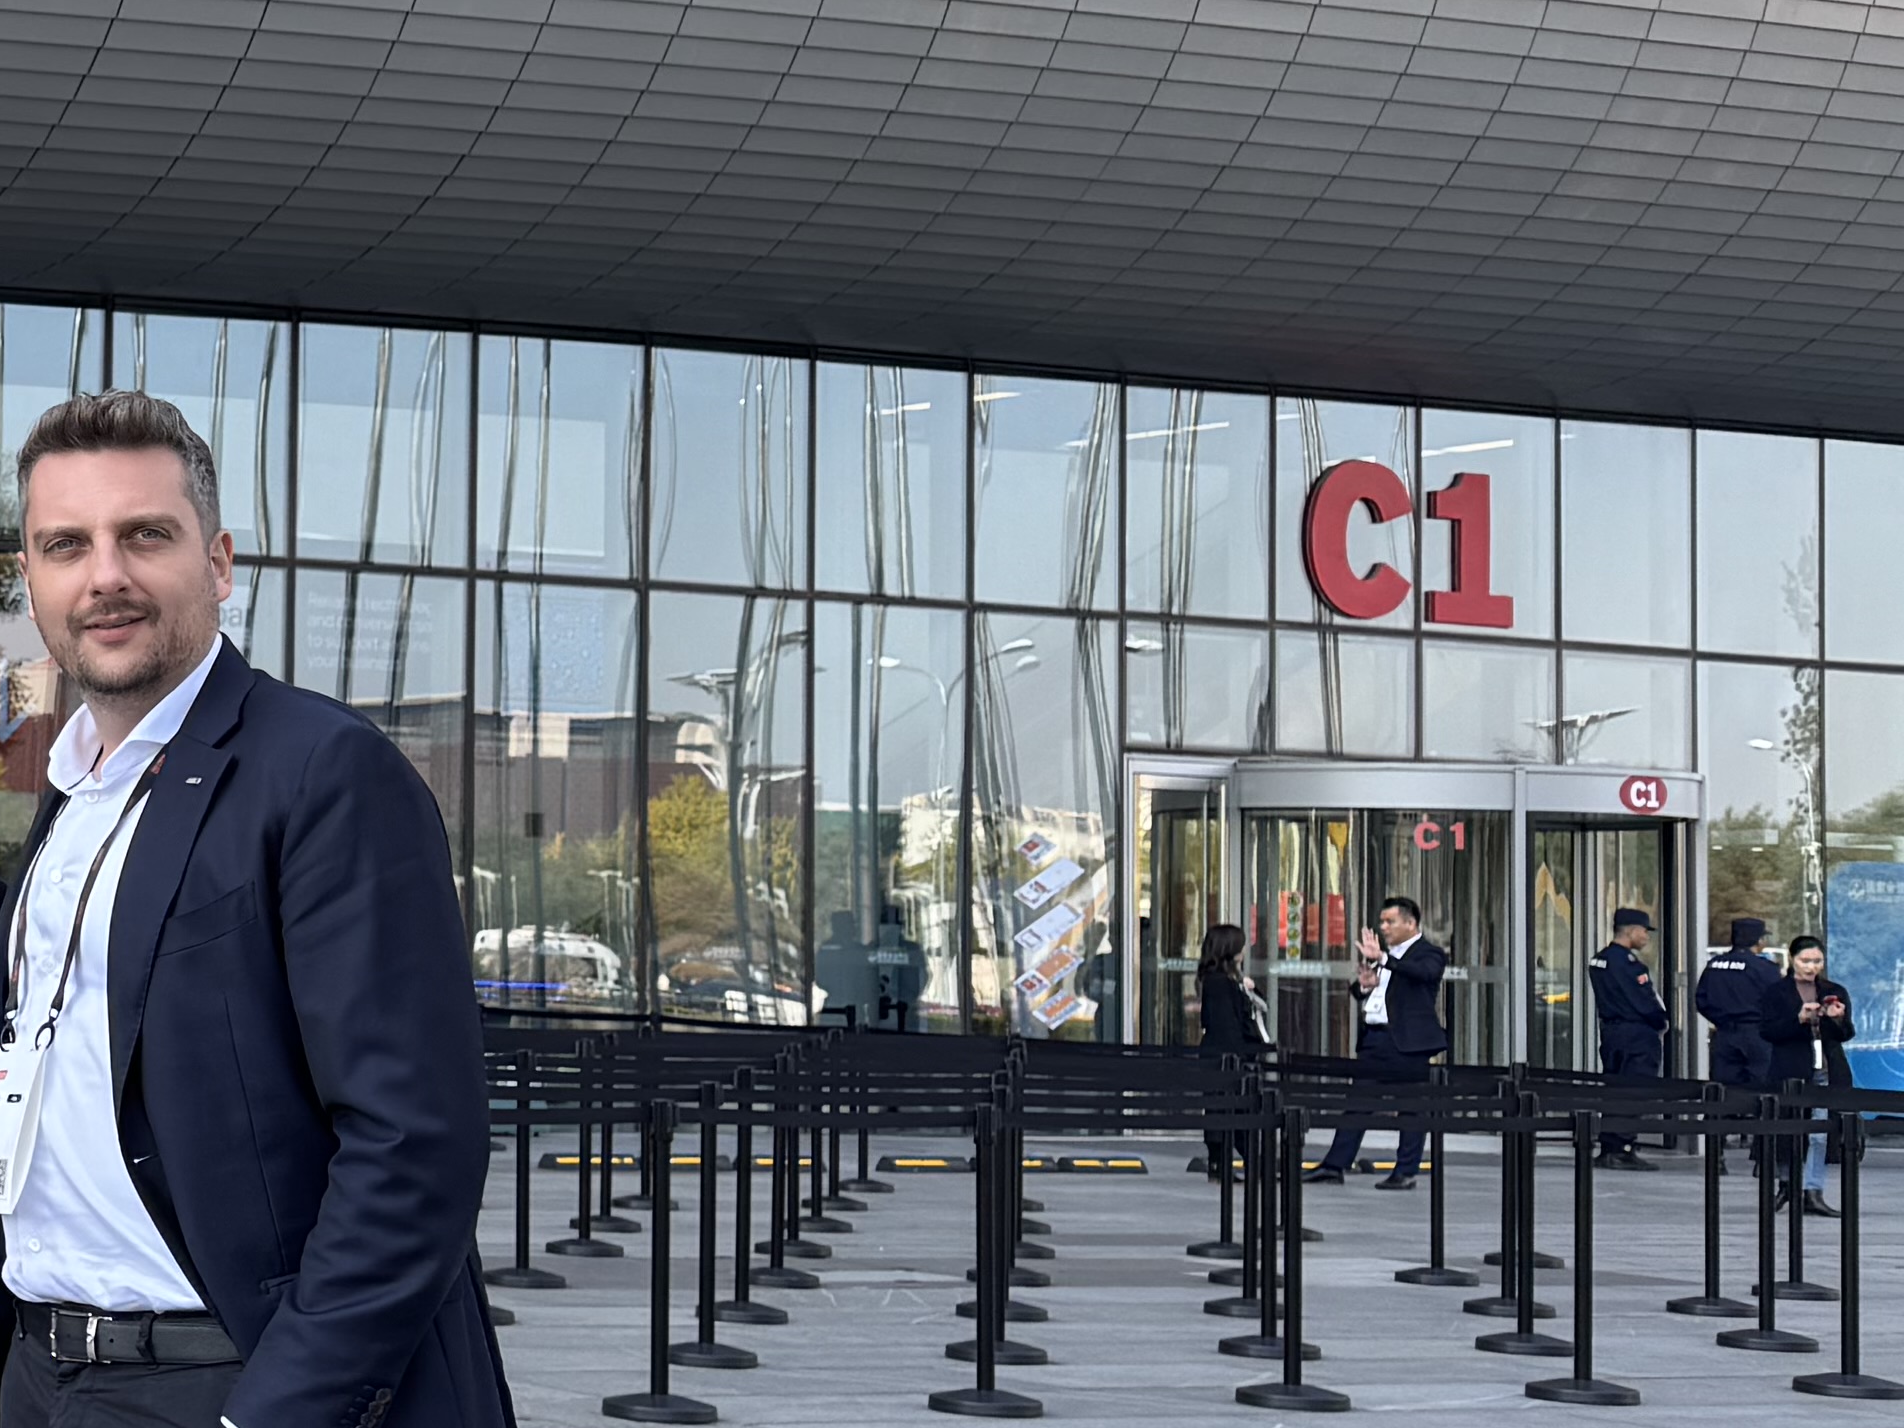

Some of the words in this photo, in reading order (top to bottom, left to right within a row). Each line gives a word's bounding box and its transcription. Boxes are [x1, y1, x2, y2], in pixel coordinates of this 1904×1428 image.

[1302, 459, 1514, 629] C1
[1629, 780, 1660, 808] C1
[1413, 822, 1466, 850] C1
